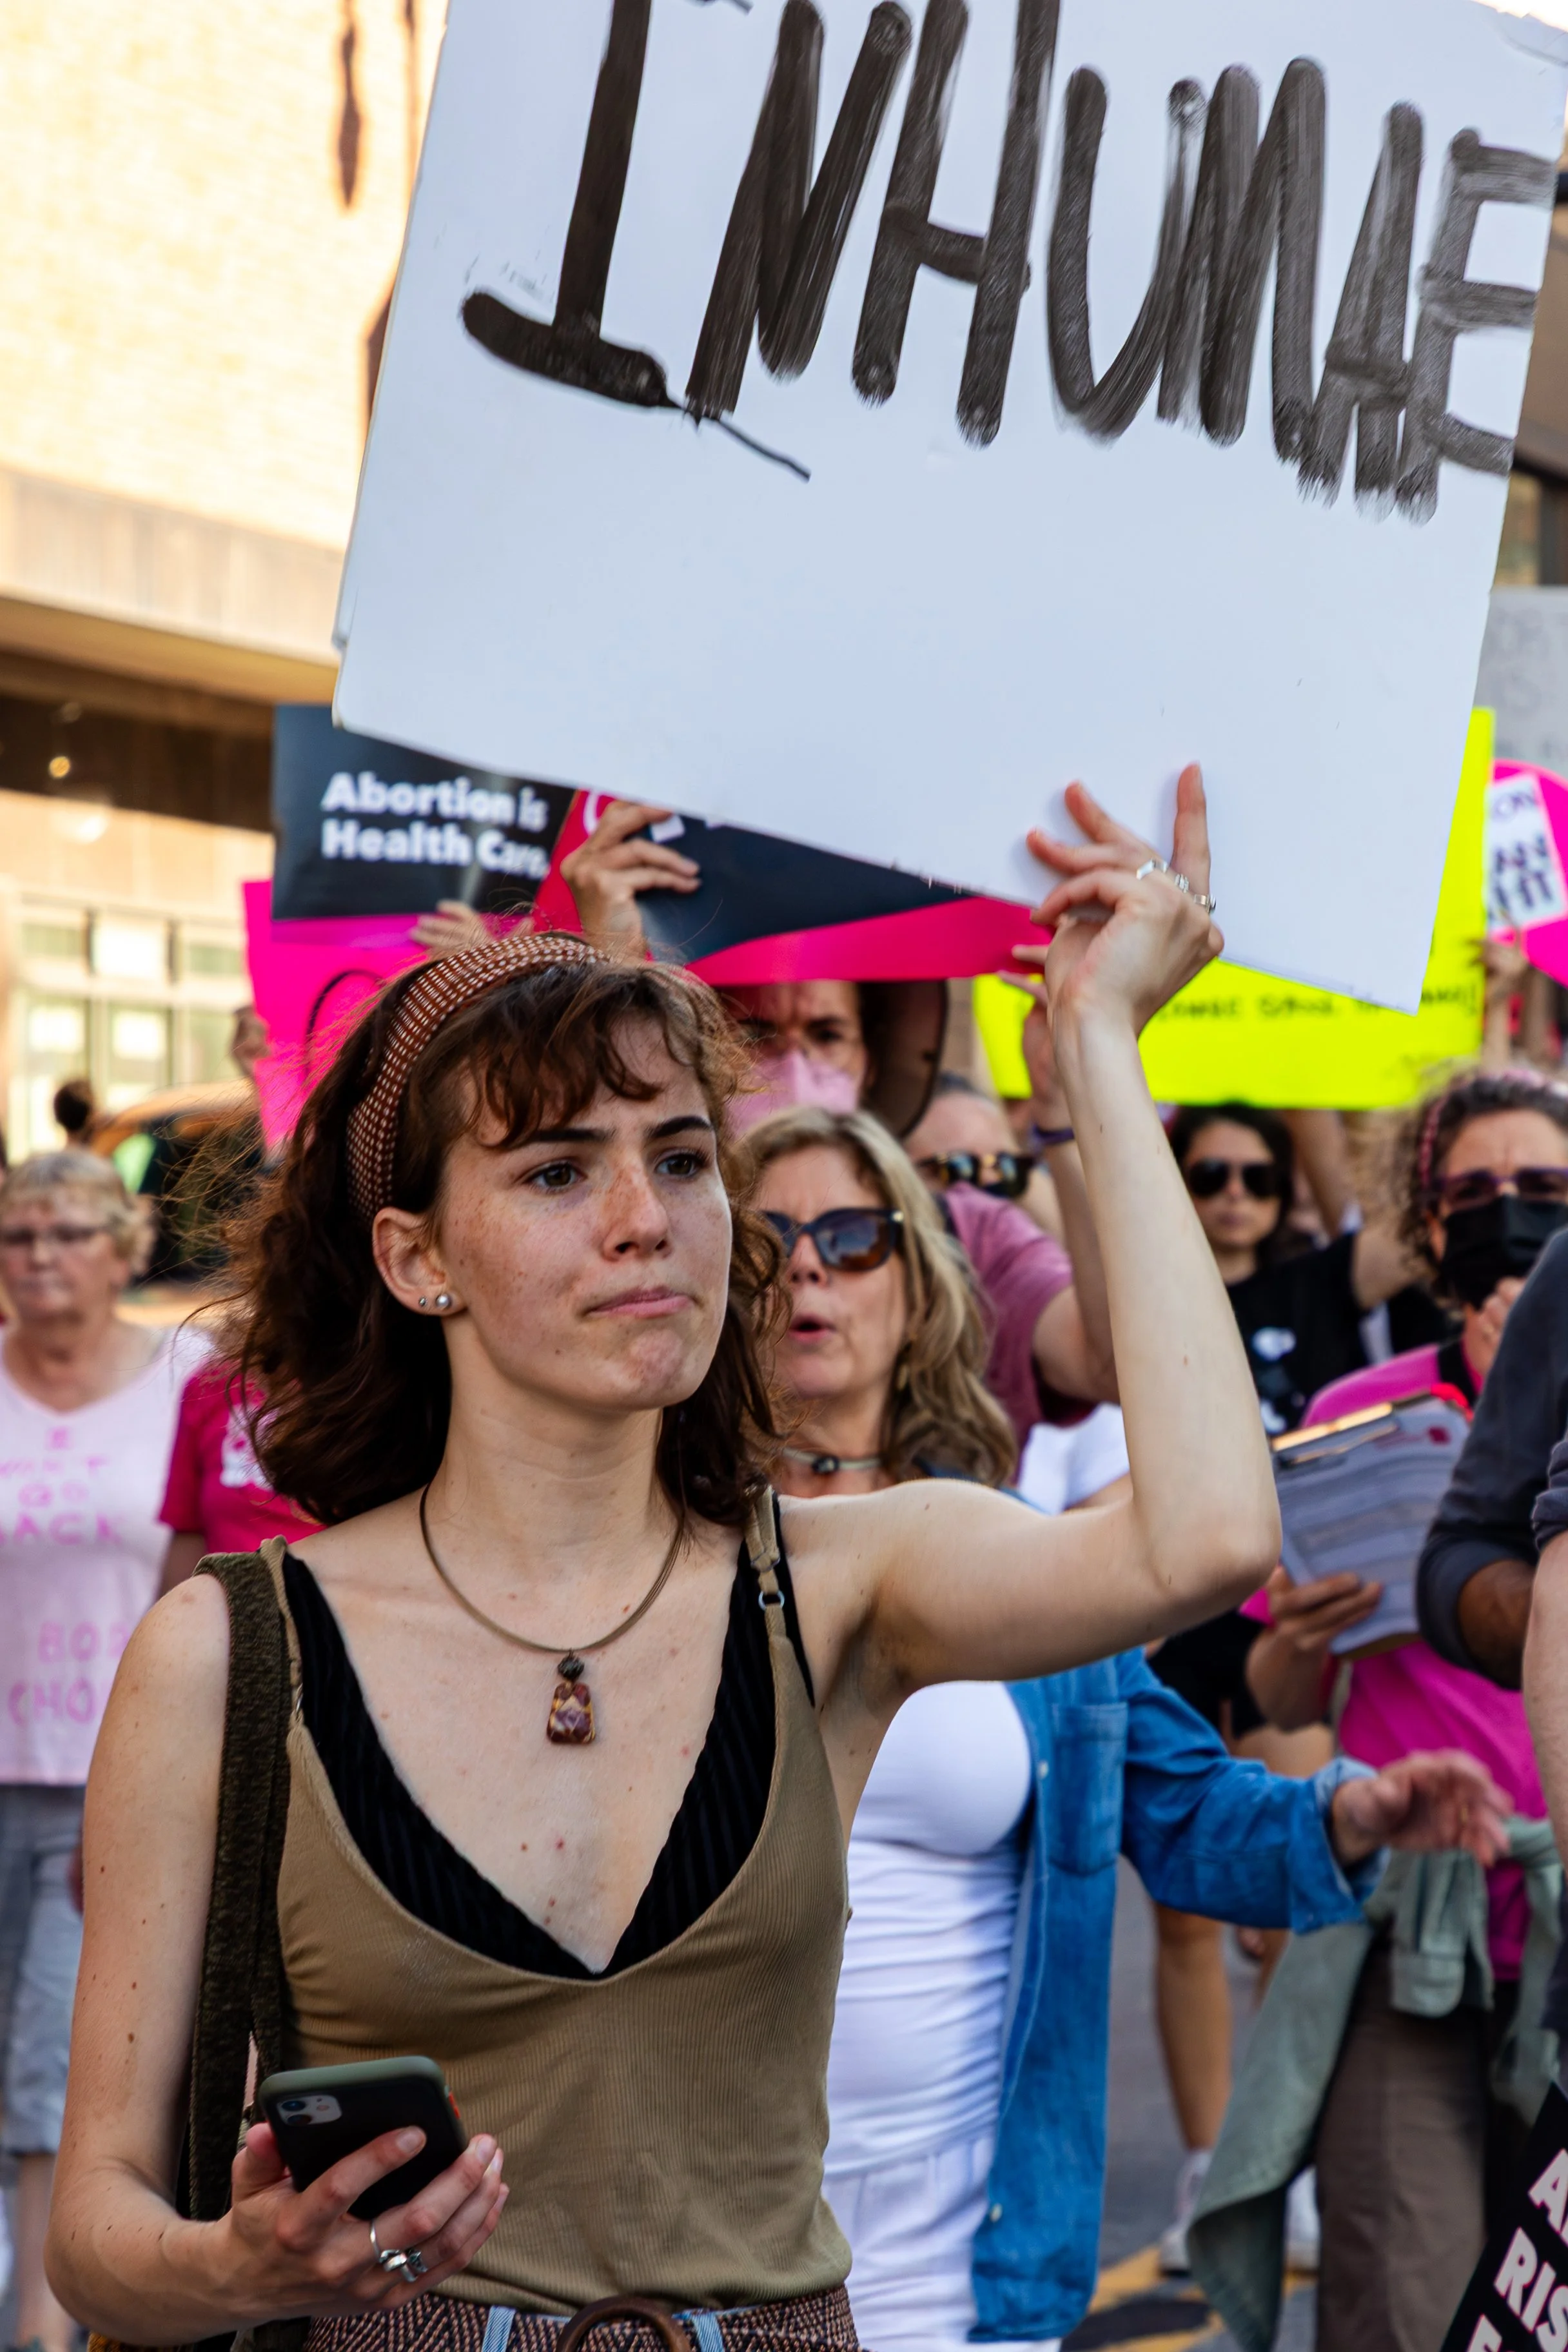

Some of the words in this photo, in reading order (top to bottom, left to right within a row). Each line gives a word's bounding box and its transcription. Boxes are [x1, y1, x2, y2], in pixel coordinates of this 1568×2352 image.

[321, 771, 514, 826] Abortion
[518, 786, 548, 833] is
[322, 818, 473, 867] Health
